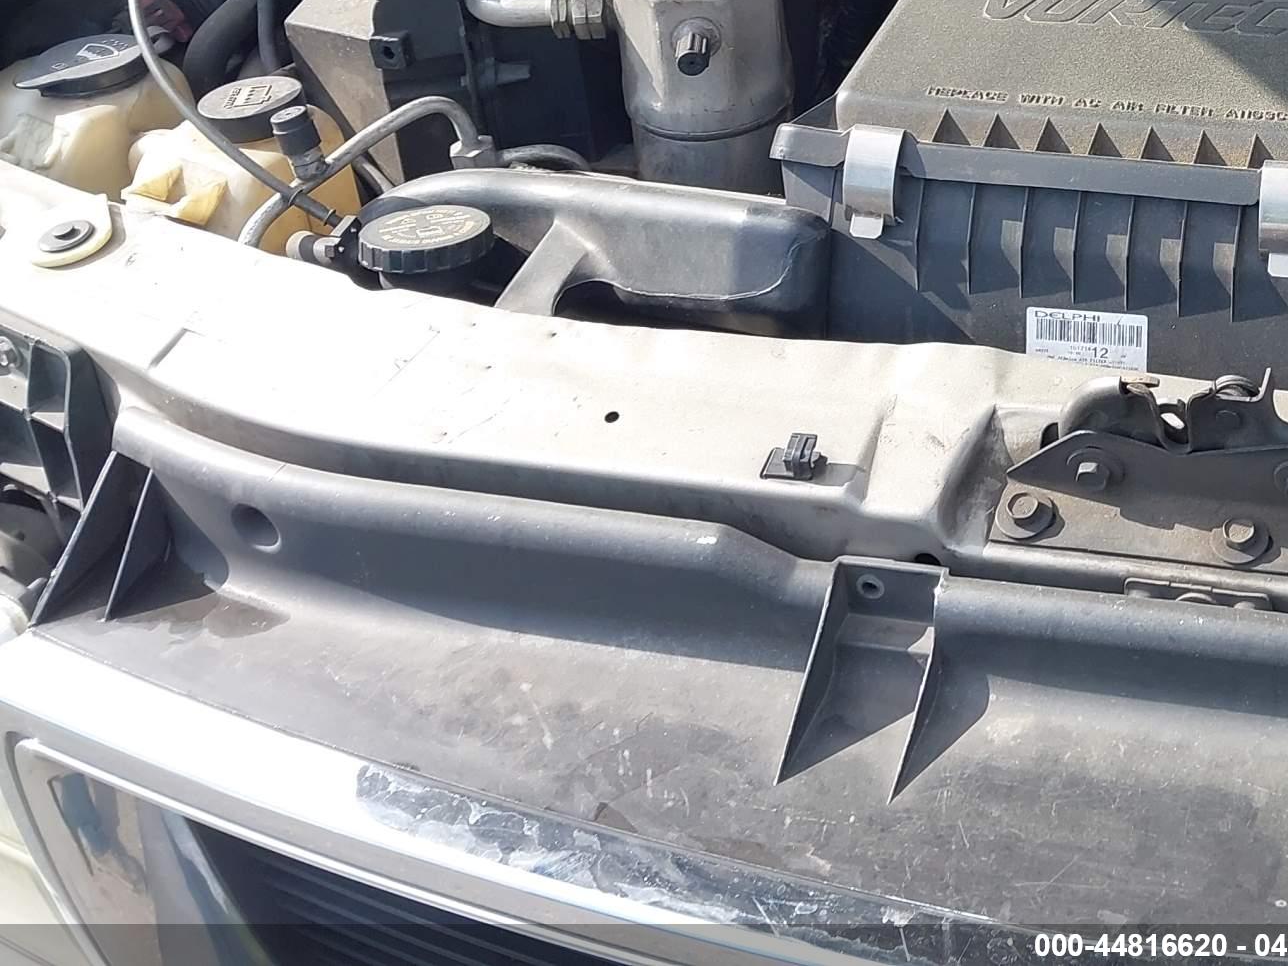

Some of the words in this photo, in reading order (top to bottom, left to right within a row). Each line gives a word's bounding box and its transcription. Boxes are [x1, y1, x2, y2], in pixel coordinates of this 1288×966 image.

[927, 86, 1009, 103] REPLACE
[1019, 94, 1066, 107] WITH
[1072, 97, 1102, 109] AC
[1111, 100, 1145, 113] AIR
[1154, 103, 1215, 118] FILTER
[1034, 310, 1101, 322] DELPHI
